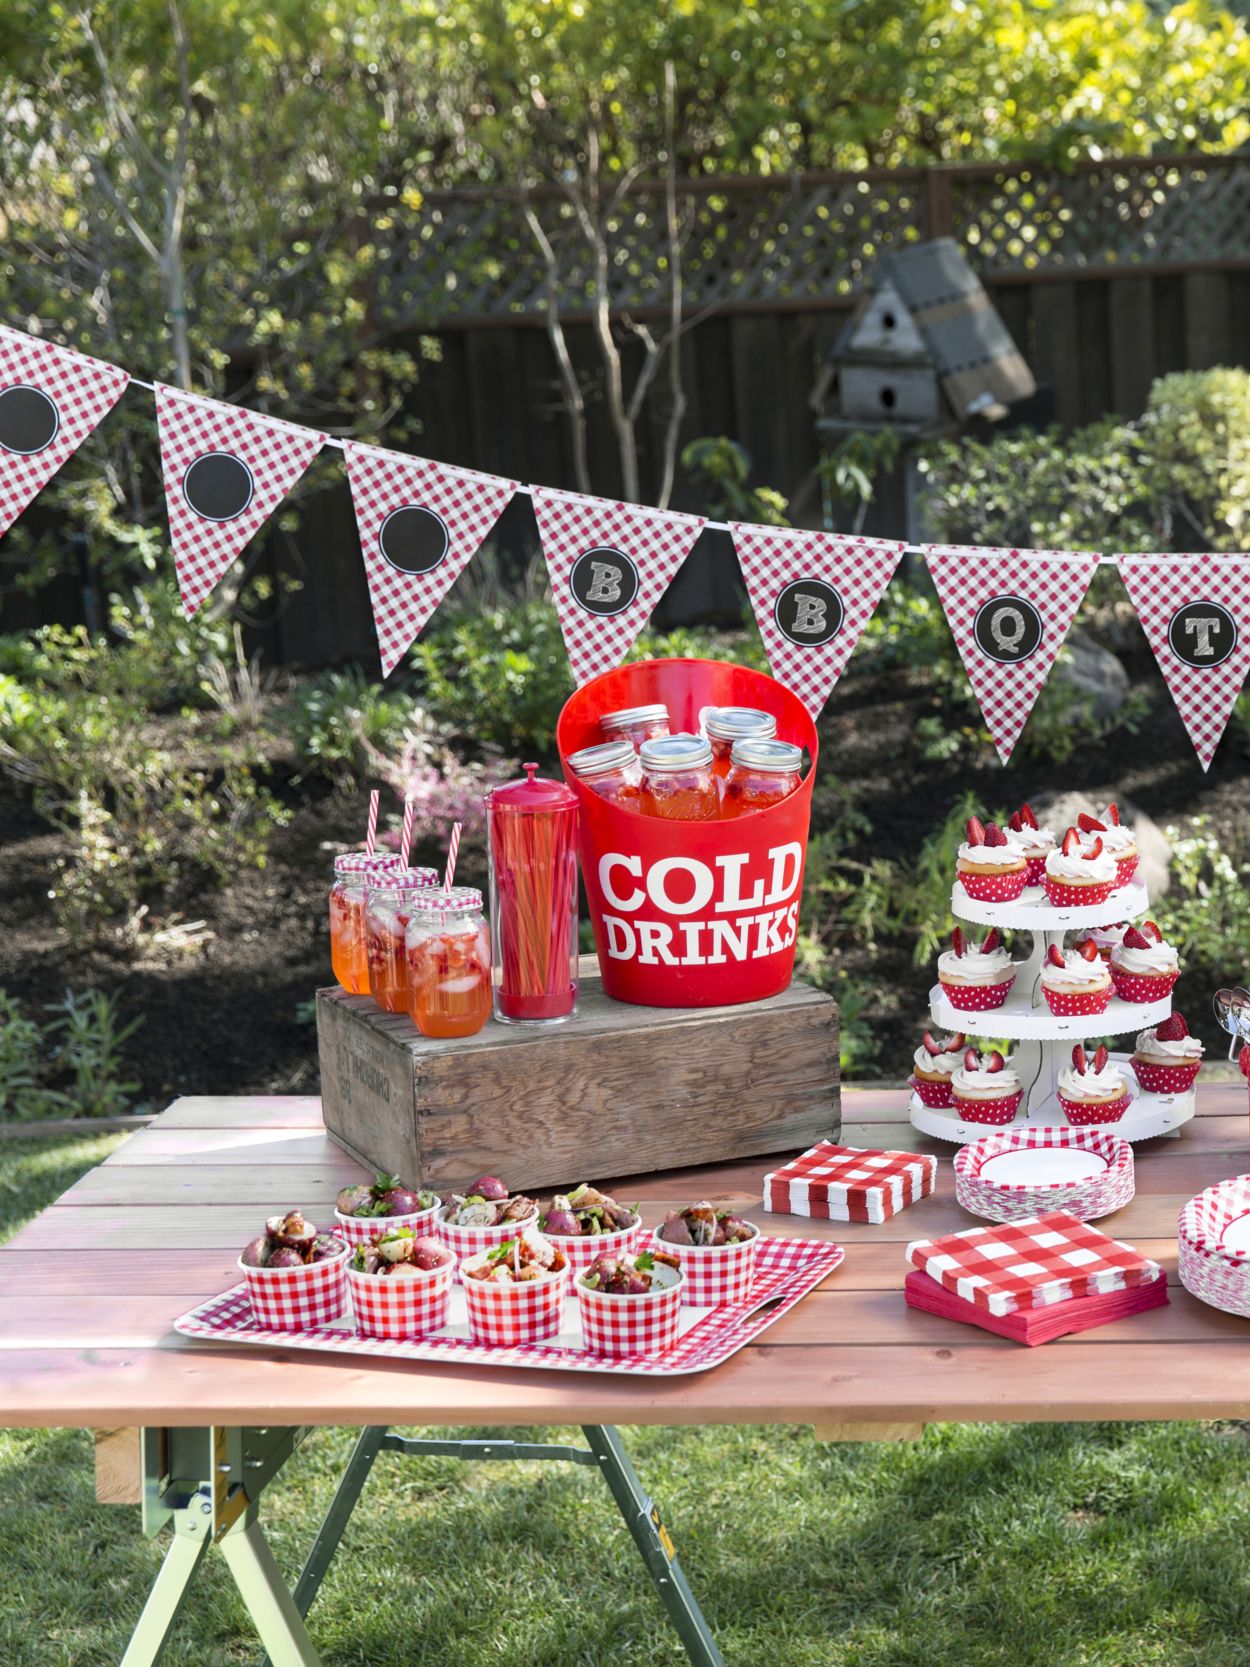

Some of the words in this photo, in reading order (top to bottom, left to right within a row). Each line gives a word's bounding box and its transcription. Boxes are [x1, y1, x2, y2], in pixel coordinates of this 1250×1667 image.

[586, 561, 622, 603] B
[792, 593, 828, 634] B
[992, 606, 1026, 653] Q
[1184, 617, 1220, 656] T
[598, 841, 802, 915] COLD
[602, 900, 799, 966] DRINKS
